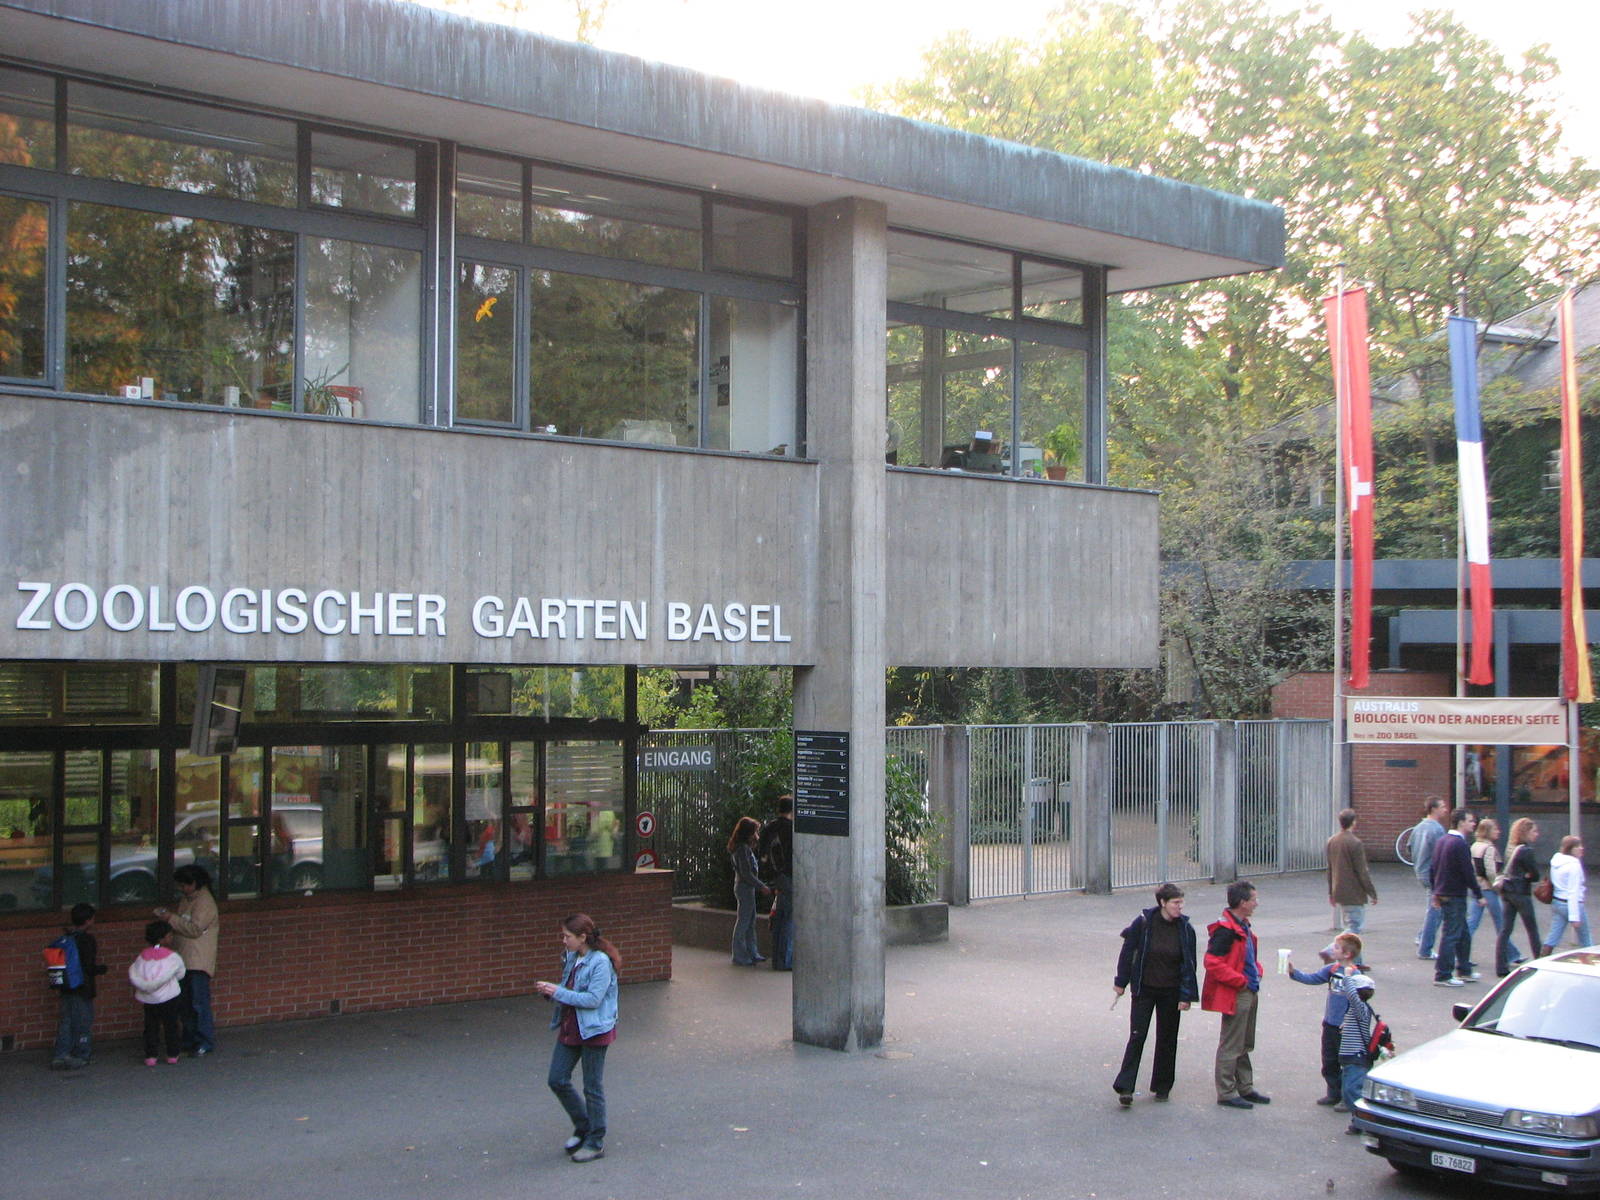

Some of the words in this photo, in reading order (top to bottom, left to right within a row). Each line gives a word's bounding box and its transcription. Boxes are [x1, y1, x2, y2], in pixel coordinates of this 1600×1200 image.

[16, 582, 447, 636] ZOOLOGISCHER
[472, 595, 647, 640] GARTEN
[667, 603, 792, 642] BASEL
[1353, 701, 1419, 712] AUSTRALIS
[1354, 713, 1408, 724] BIOLOGIE
[1411, 714, 1436, 724] VON
[1438, 714, 1462, 725] DER
[1465, 715, 1522, 725] ANDEREN
[1526, 715, 1560, 725] SEITE
[644, 750, 712, 767] EINGANG
